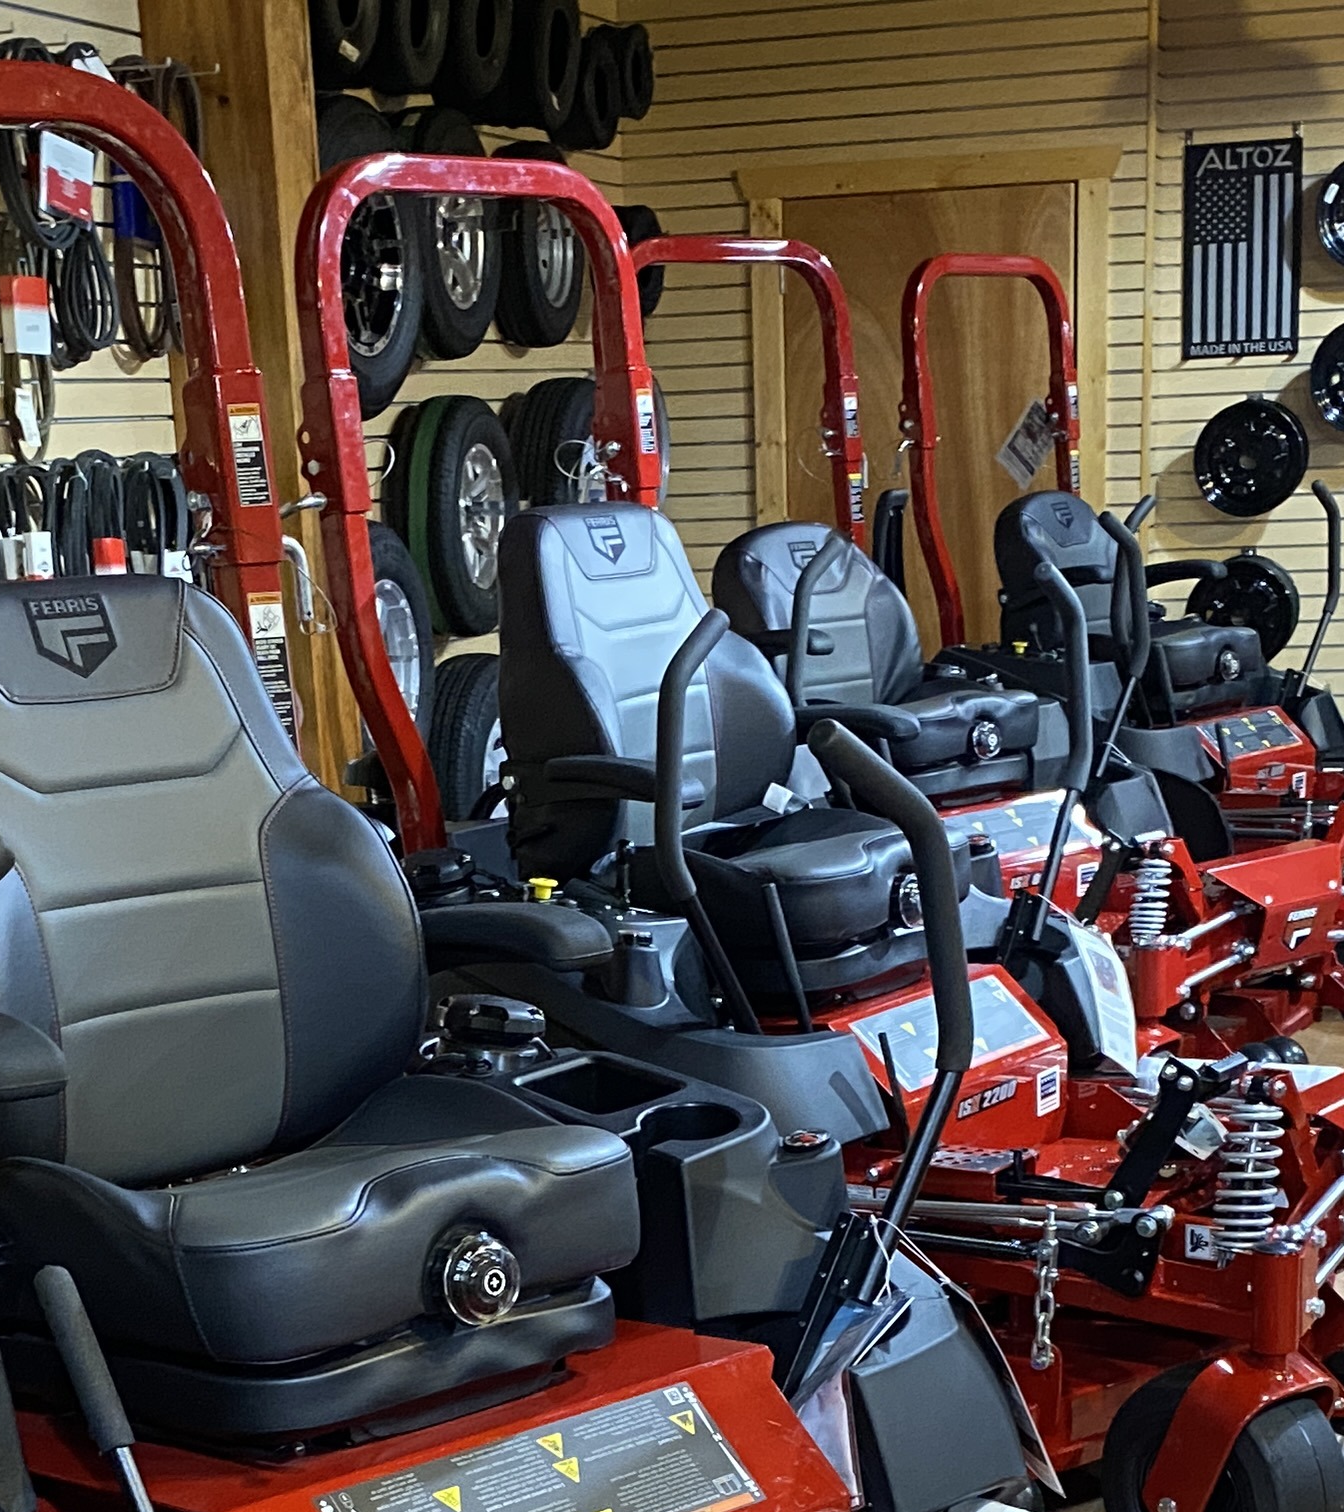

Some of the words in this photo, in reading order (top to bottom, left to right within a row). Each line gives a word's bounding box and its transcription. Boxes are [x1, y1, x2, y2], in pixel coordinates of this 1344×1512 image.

[1195, 143, 1294, 178] ALTOZ
[1189, 343, 1225, 356] MADE
[1228, 343, 1241, 354] IN
[1242, 341, 1266, 353] THE
[1268, 340, 1293, 352] USA
[29, 597, 99, 616] FERRIS
[982, 1079, 1018, 1109] 2200
